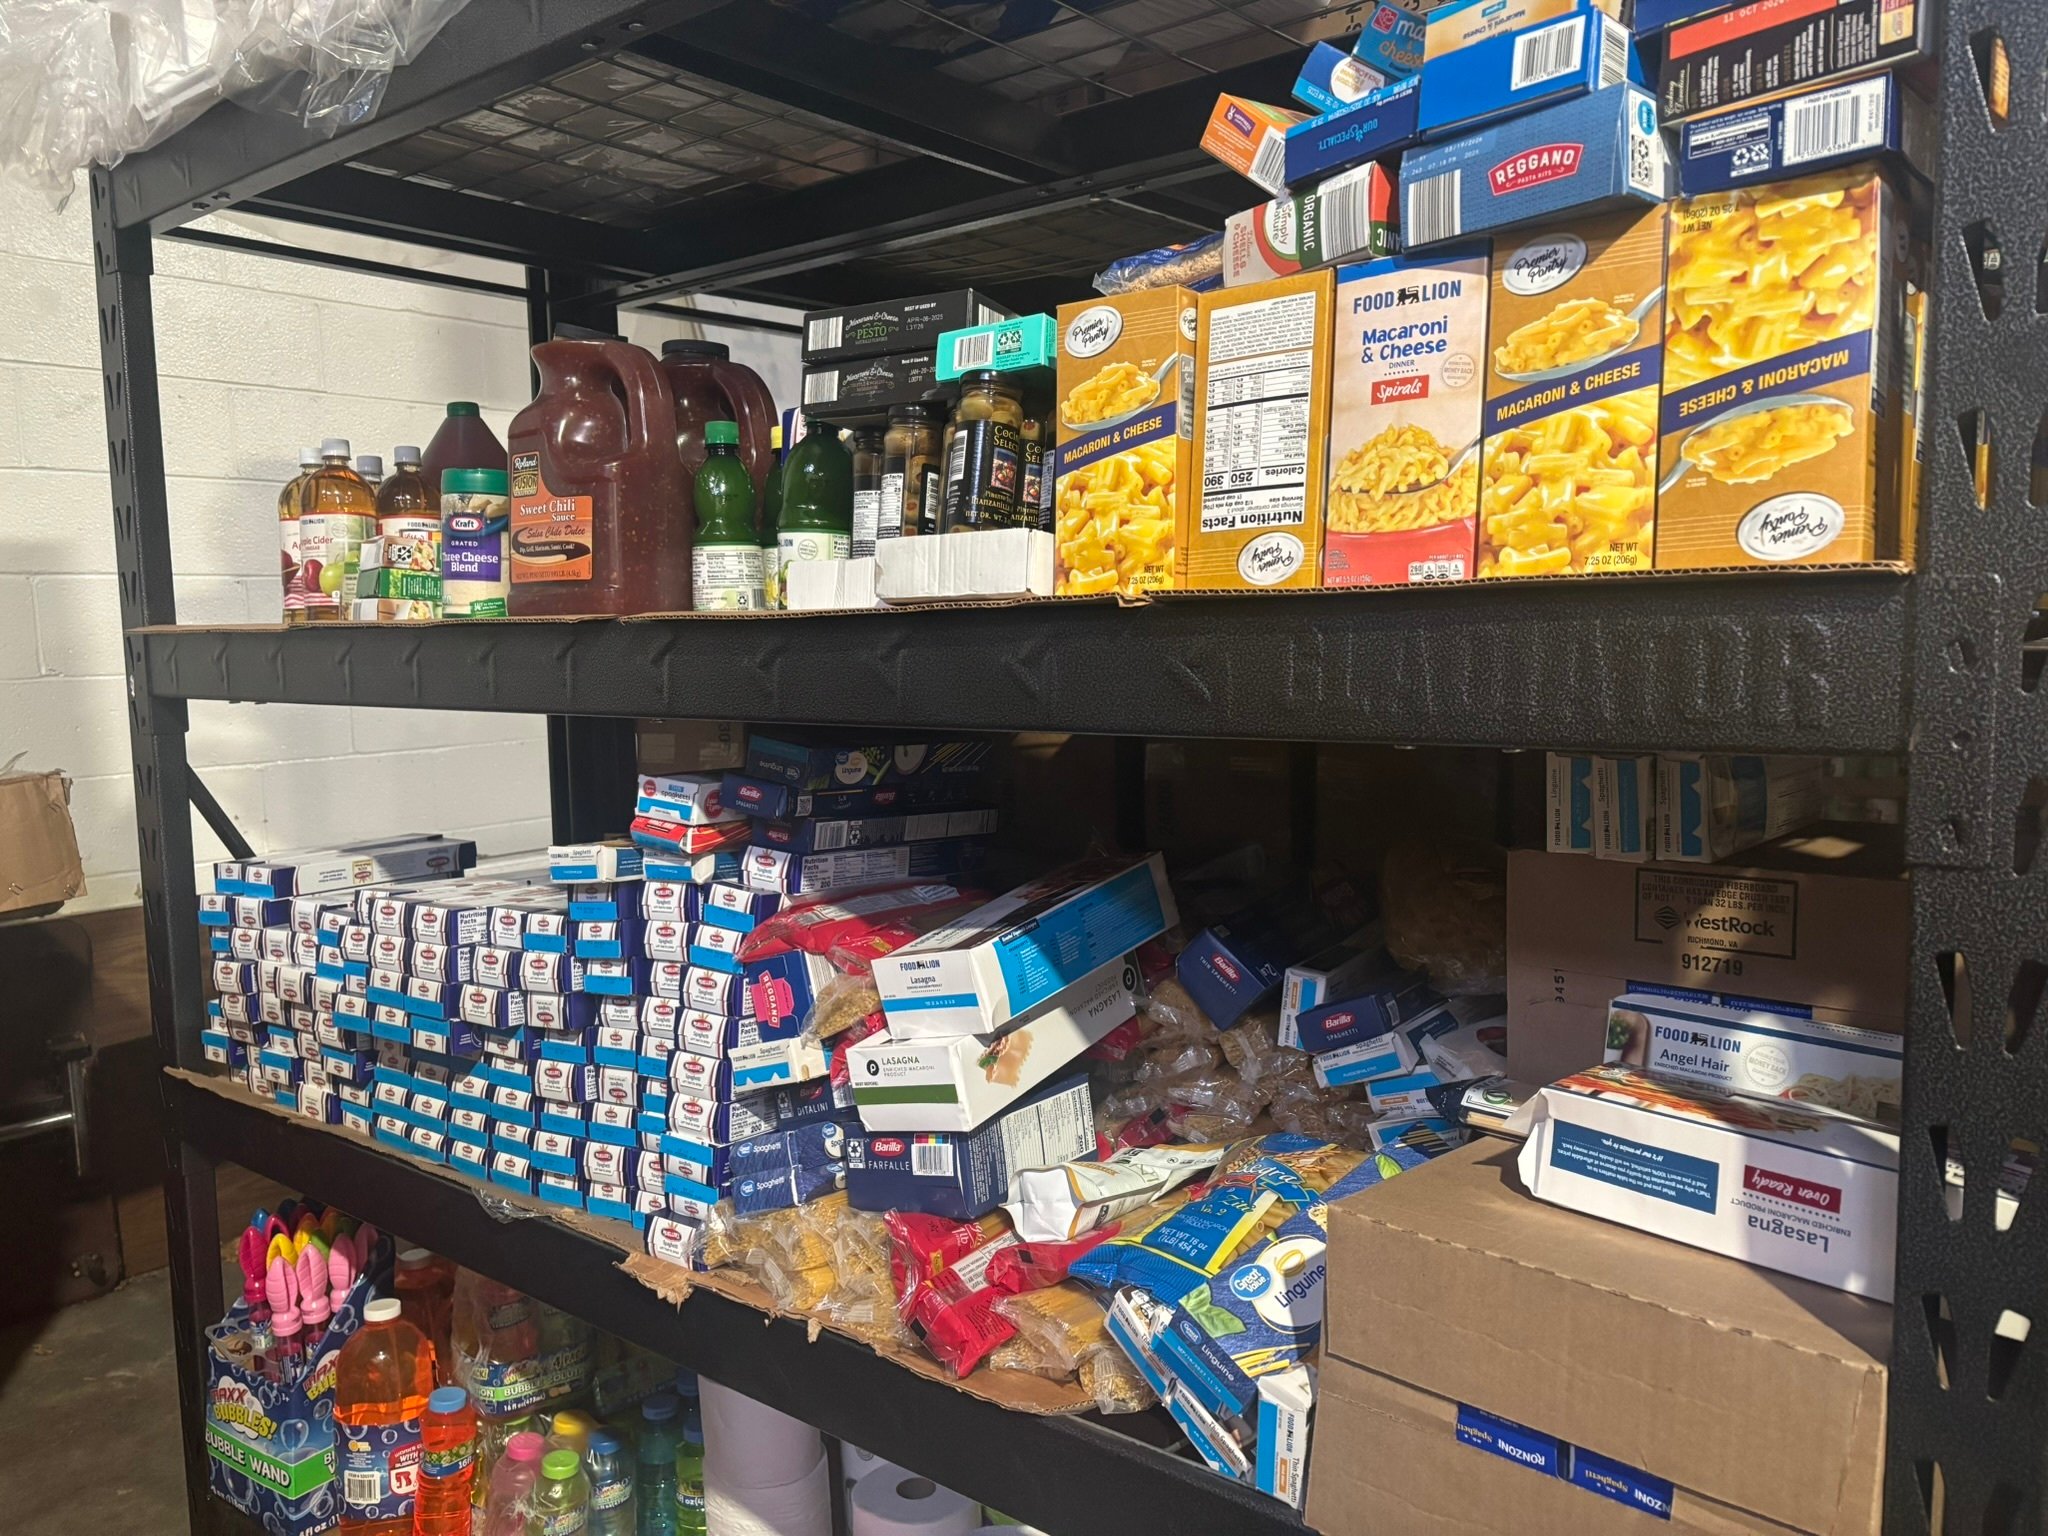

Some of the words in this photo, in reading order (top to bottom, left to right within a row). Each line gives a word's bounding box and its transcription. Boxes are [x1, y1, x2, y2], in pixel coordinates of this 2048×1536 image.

[1740, 4, 1758, 18] OCT
[1664, 81, 1677, 116] Cooking
[1362, 118, 1378, 132] OUR
[1495, 148, 1576, 186] REGGANO
[1517, 174, 1536, 184] PASTA
[1281, 203, 1292, 246] Simply
[1303, 194, 1316, 252] ORGANIC
[1694, 220, 1712, 232] NET
[1514, 244, 1561, 279] Premier
[1526, 255, 1569, 284] Pantry
[1353, 292, 1395, 314] FOOD
[1421, 280, 1462, 302] LION
[857, 326, 887, 340] PESTO
[1072, 318, 1104, 342] Premier
[1362, 316, 1448, 346] Macaroni
[1082, 328, 1110, 350] Pantry
[1361, 346, 1374, 364] &
[1380, 339, 1448, 362] Cheese
[1388, 360, 1415, 370] DINNER
[1758, 347, 1850, 390] MACARONI
[1376, 378, 1423, 402] Spirals
[1496, 386, 1566, 422] MACARONI
[1569, 380, 1580, 396] &
[1584, 361, 1642, 390] CHEESE
[1742, 379, 1754, 395] &
[1678, 386, 1737, 418] CHEESE
[1064, 434, 1111, 465] MACARONI
[1112, 430, 1121, 445] &
[1124, 416, 1162, 440] CHEESE
[514, 456, 538, 470] Roland
[514, 475, 538, 490] FUSION
[1204, 475, 1224, 487] 390
[1230, 471, 1254, 483] 250
[1264, 466, 1305, 478] Calories
[520, 504, 548, 516] Sweet
[549, 498, 576, 512] Chili
[1282, 496, 1304, 504] Serving
[454, 519, 475, 528] Kraft
[552, 513, 576, 522] Sauce
[1202, 516, 1236, 530] Facts
[1240, 510, 1303, 526] Nutrition
[1758, 504, 1810, 533] Pantry
[527, 528, 544, 538] Salsa
[564, 525, 586, 536] Dulce
[1768, 517, 1828, 546] Premier
[312, 535, 334, 545] Cider
[1609, 542, 1624, 552] NET
[1626, 542, 1638, 552] WT
[462, 552, 498, 564] Cheese
[1584, 556, 1600, 566] 7.25
[1602, 555, 1612, 566] OZ
[1613, 554, 1638, 566] (206g)
[451, 562, 478, 572] Blend
[1144, 565, 1155, 574] NET
[1155, 564, 1164, 573] WT
[660, 790, 691, 801] spaghetti
[740, 788, 760, 799] Barilla
[1725, 880, 1779, 893] FIBERBOARD
[1715, 889, 1738, 900] EDGE
[1738, 891, 1765, 902] CRUSH
[1715, 898, 1726, 908] 32
[1728, 900, 1746, 910] LBS.
[1747, 902, 1764, 912] PER
[460, 910, 487, 919] Nutrition
[1687, 936, 1727, 948] RICHMOND,
[1728, 940, 1739, 949] VA
[900, 962, 916, 972] FOOD
[924, 960, 941, 969] LION
[1213, 956, 1240, 980] Barilla
[1681, 954, 1744, 977] 912719
[910, 976, 937, 985] Lasagna
[1200, 956, 1212, 970] THIN
[1211, 970, 1238, 996] SPAGHETTI
[1088, 990, 1121, 1018] LASAGNA
[1324, 1014, 1353, 1028] Barilla
[1326, 1028, 1359, 1041] SPAGHETTI
[1655, 1026, 1690, 1043] FOOD
[1710, 1036, 1742, 1054] LION
[1354, 1036, 1384, 1050] Spaghetti
[882, 1056, 920, 1066] LASAGNA
[1660, 1048, 1698, 1066] Angel
[1701, 1056, 1730, 1072] Hair
[1749, 1057, 1770, 1070] MONEY
[1770, 1064, 1787, 1075] BACK
[1654, 1062, 1679, 1071] ENRICHED
[1680, 1066, 1708, 1077] MACARONI
[1708, 1072, 1733, 1082] PRODUCT
[732, 1110, 749, 1119] Facts
[796, 1102, 829, 1116] DITALINI
[750, 1124, 762, 1134] 200
[752, 1142, 782, 1153] Spaghetti
[874, 1142, 902, 1153] Barilla
[868, 1160, 910, 1171] FARFALLE
[756, 1176, 785, 1190] Spaghetti
[1752, 1170, 1794, 1197] Ready
[1663, 1188, 1677, 1197] What
[1798, 1187, 1831, 1206] Oven
[1730, 1198, 1766, 1213] PRODUCT
[1768, 1208, 1810, 1226] MACARONI
[1748, 1214, 1830, 1254] Lasagna
[1812, 1220, 1852, 1238] ENRICHED
[1159, 1226, 1175, 1238] NET
[1176, 1230, 1190, 1241] WT
[1190, 1236, 1199, 1246] 16
[1198, 1241, 1208, 1251] oz
[1177, 1241, 1192, 1253] 454
[1234, 1268, 1262, 1290] Great
[1246, 1275, 1268, 1294] Value
[1274, 1264, 1327, 1309] Linguine
[1201, 1344, 1236, 1382] Linguine
[210, 1388, 248, 1403] MAXX
[214, 1404, 278, 1441] BUBBLES!
[1286, 1412, 1295, 1432] FOOD
[205, 1430, 245, 1465] BUBBLE
[250, 1454, 291, 1487] WAND
[400, 1452, 418, 1462] WITH
[1498, 1438, 1546, 1467] RONZONI
[1292, 1457, 1300, 1473] Thin
[1290, 1473, 1300, 1503] Spaghetti
[1584, 1469, 1629, 1493] Spaghetti
